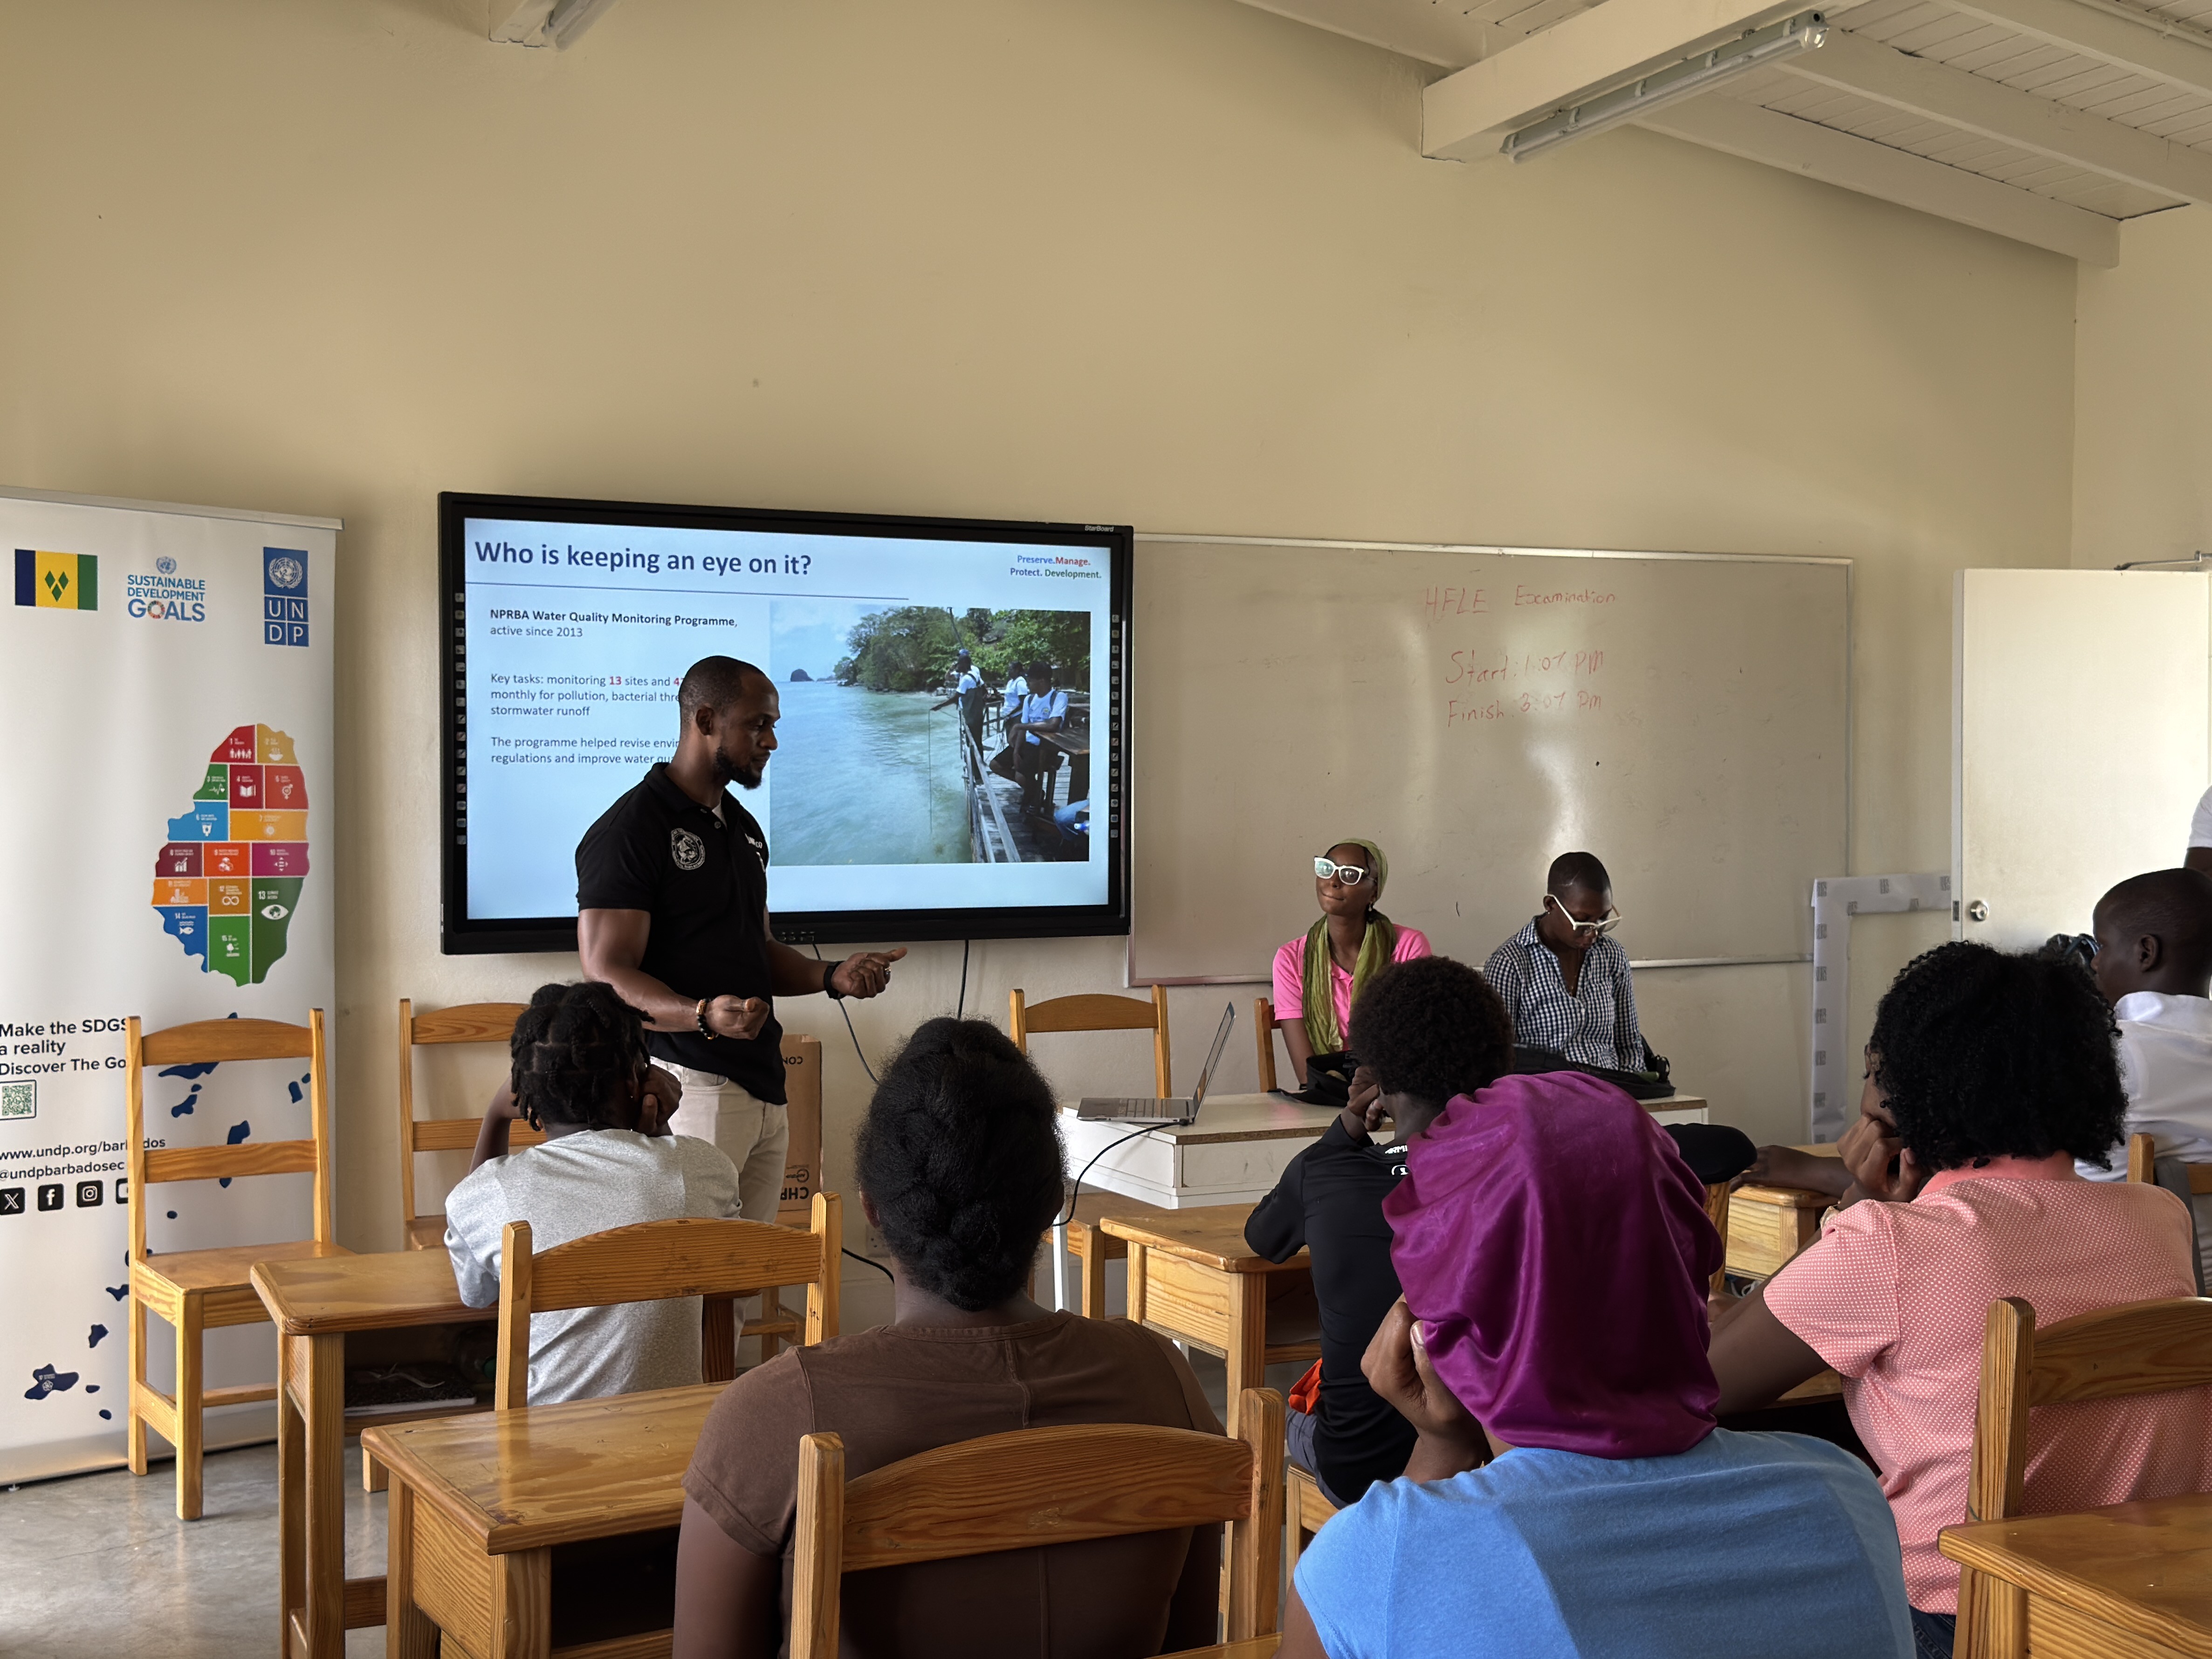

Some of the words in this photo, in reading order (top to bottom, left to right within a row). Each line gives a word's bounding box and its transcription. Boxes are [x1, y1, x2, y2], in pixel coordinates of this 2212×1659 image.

[474, 541, 533, 563] Who
[542, 544, 559, 565] is
[568, 545, 660, 574] keeping
[667, 555, 694, 570] an
[702, 556, 742, 576] eye
[749, 558, 776, 574] on
[784, 555, 811, 575] it?
[1010, 568, 1043, 576] Protect.
[1044, 569, 1102, 580] Development.
[127, 575, 206, 590] SUSTAINABLE
[127, 587, 206, 601] DEVELOPMENT
[127, 598, 206, 622] GOALS
[490, 609, 529, 620] NPRBA
[532, 610, 566, 621] Water
[569, 612, 609, 624] Quality
[612, 613, 672, 626] Monitoring
[674, 615, 737, 627] Programme,
[490, 626, 523, 636] active
[526, 626, 553, 637] since
[556, 627, 583, 638] 2013
[491, 673, 510, 685] Key
[513, 674, 543, 684] tasks:
[547, 675, 606, 687] monitoring
[610, 676, 622, 686] 13
[625, 677, 648, 686] sites
[651, 677, 670, 686] and
[491, 690, 536, 701] monthly
[539, 689, 555, 700] for
[558, 690, 609, 702] pollution,
[612, 691, 657, 701] bacterial
[491, 706, 554, 715] stormwater
[556, 706, 591, 716] runoff
[491, 736, 512, 747] The
[515, 739, 577, 749] programme
[580, 737, 617, 749] helped
[620, 738, 651, 747] revise
[491, 753, 552, 765] regulations
[555, 753, 575, 763] and
[578, 754, 621, 765] improve
[624, 755, 654, 764] water
[258, 891, 266, 900] 13
[0, 1022, 46, 1037] Make
[49, 1021, 77, 1035] the
[0, 1045, 7, 1056] a
[14, 1039, 66, 1056] reality
[0, 1062, 67, 1076] Discover
[70, 1058, 100, 1071] The
